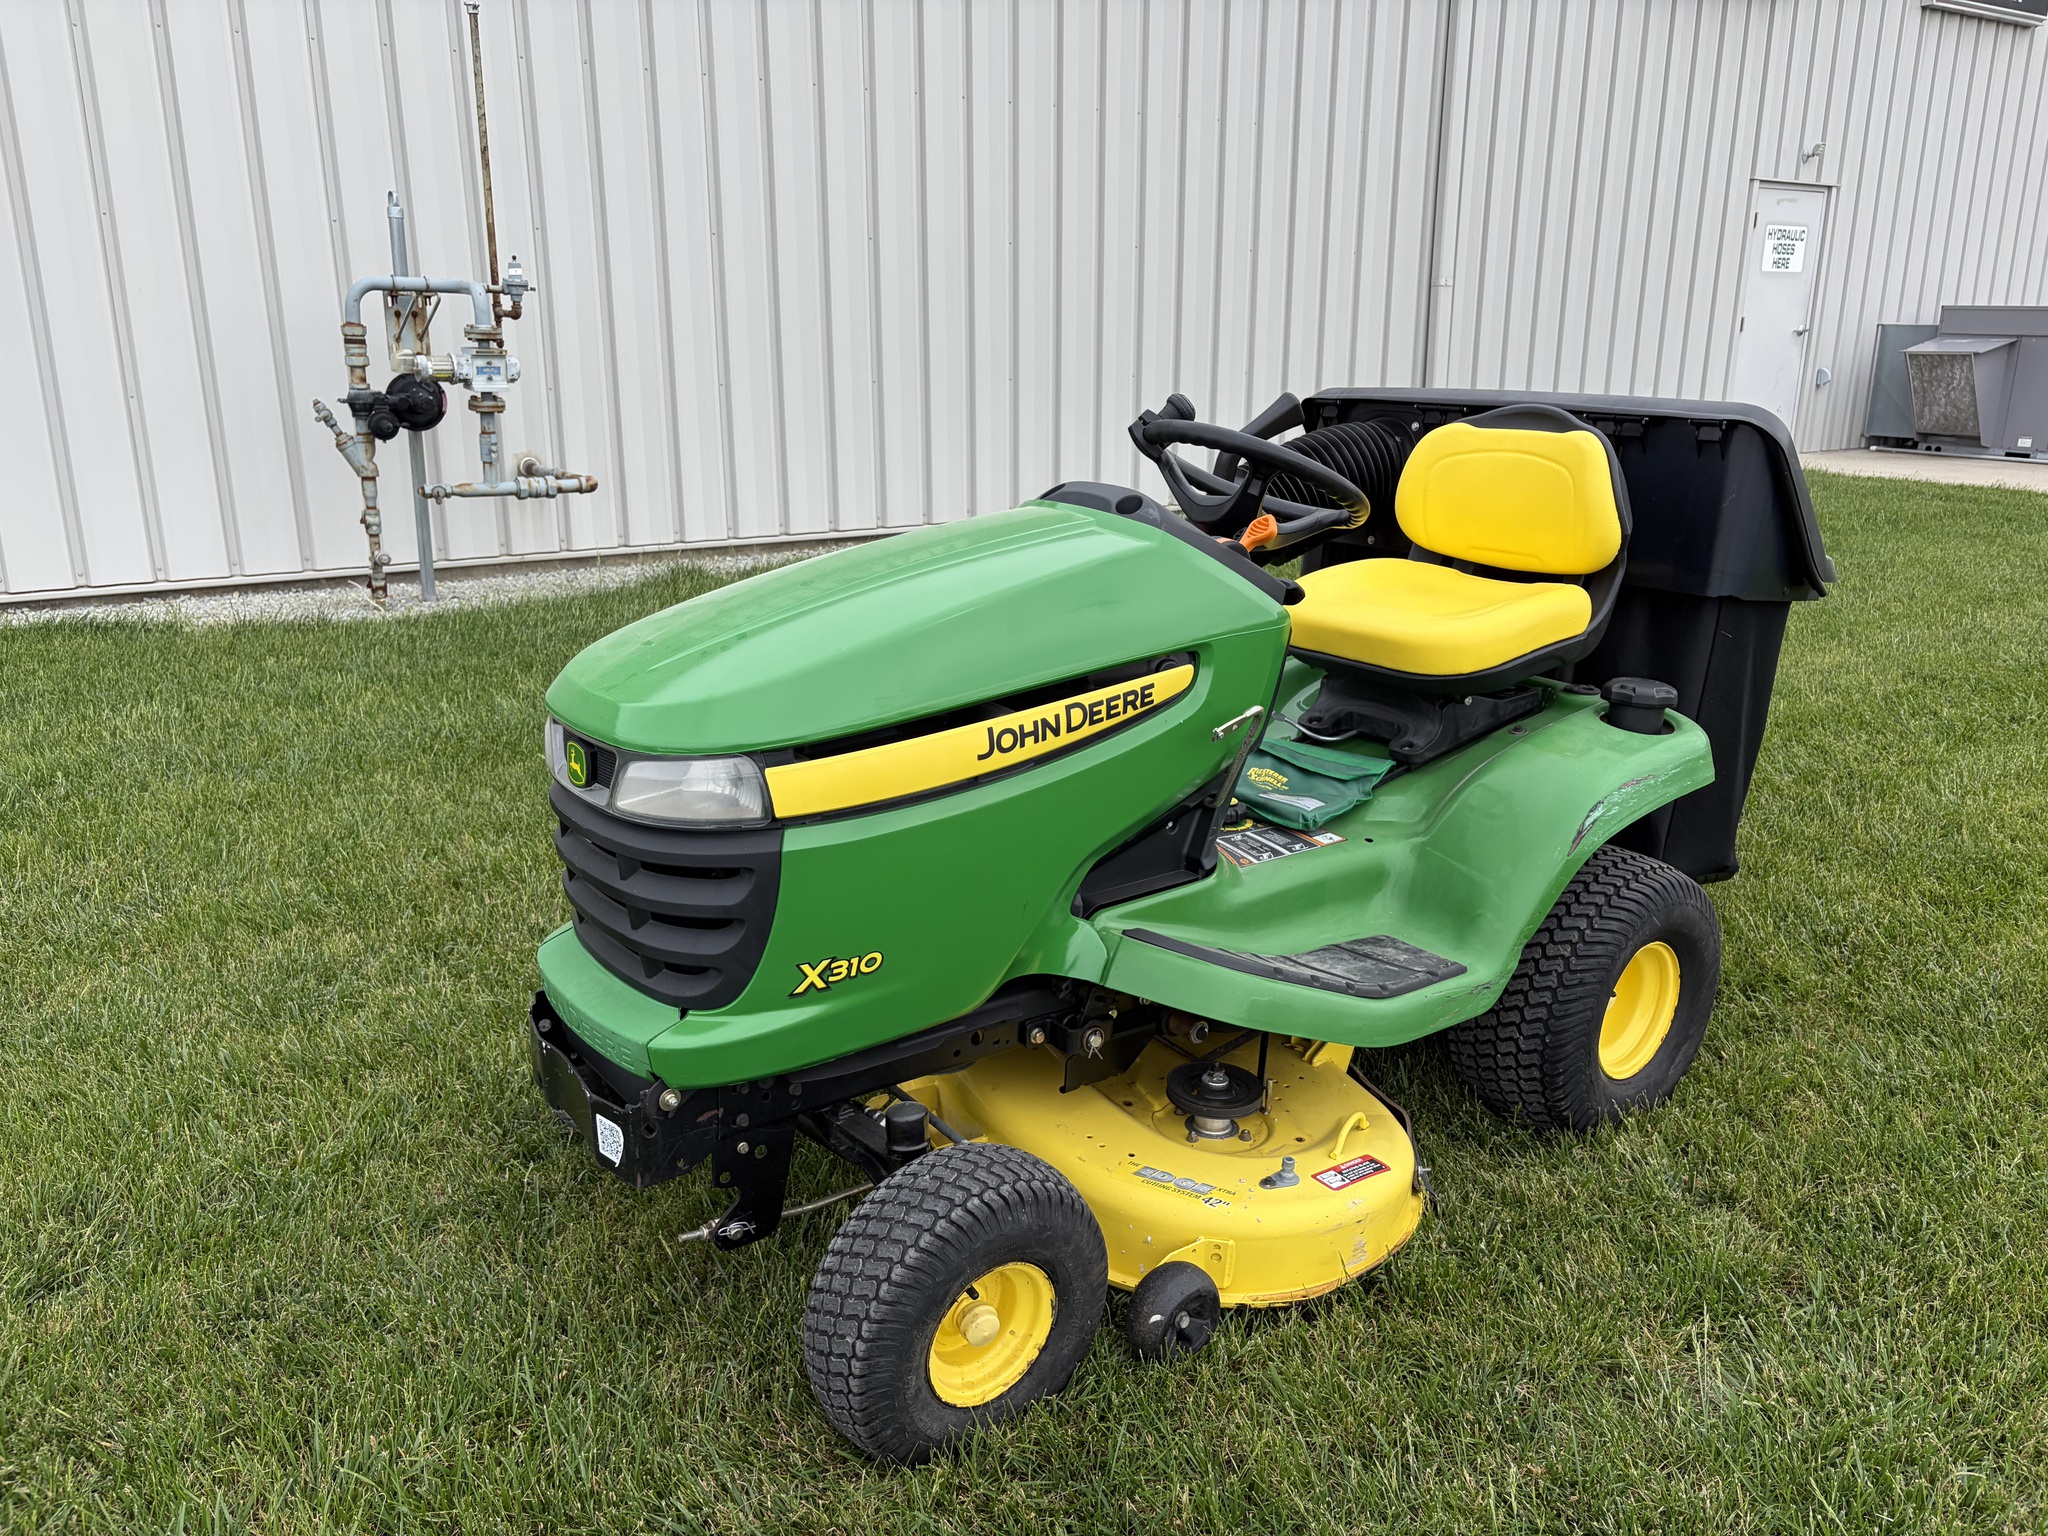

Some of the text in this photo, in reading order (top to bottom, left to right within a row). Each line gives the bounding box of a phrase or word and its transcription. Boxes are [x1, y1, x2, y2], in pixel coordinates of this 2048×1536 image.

[1767, 228, 1806, 241] HYDRAULIC
[1772, 242, 1796, 255] HOSES
[1772, 256, 1791, 269] HERE
[977, 682, 1156, 761] JOHN DEERE
[787, 951, 884, 999] X310
[1131, 1166, 1217, 1196] EDGE
[1141, 1178, 1231, 1208] CUTTING SYSTEM 42"
